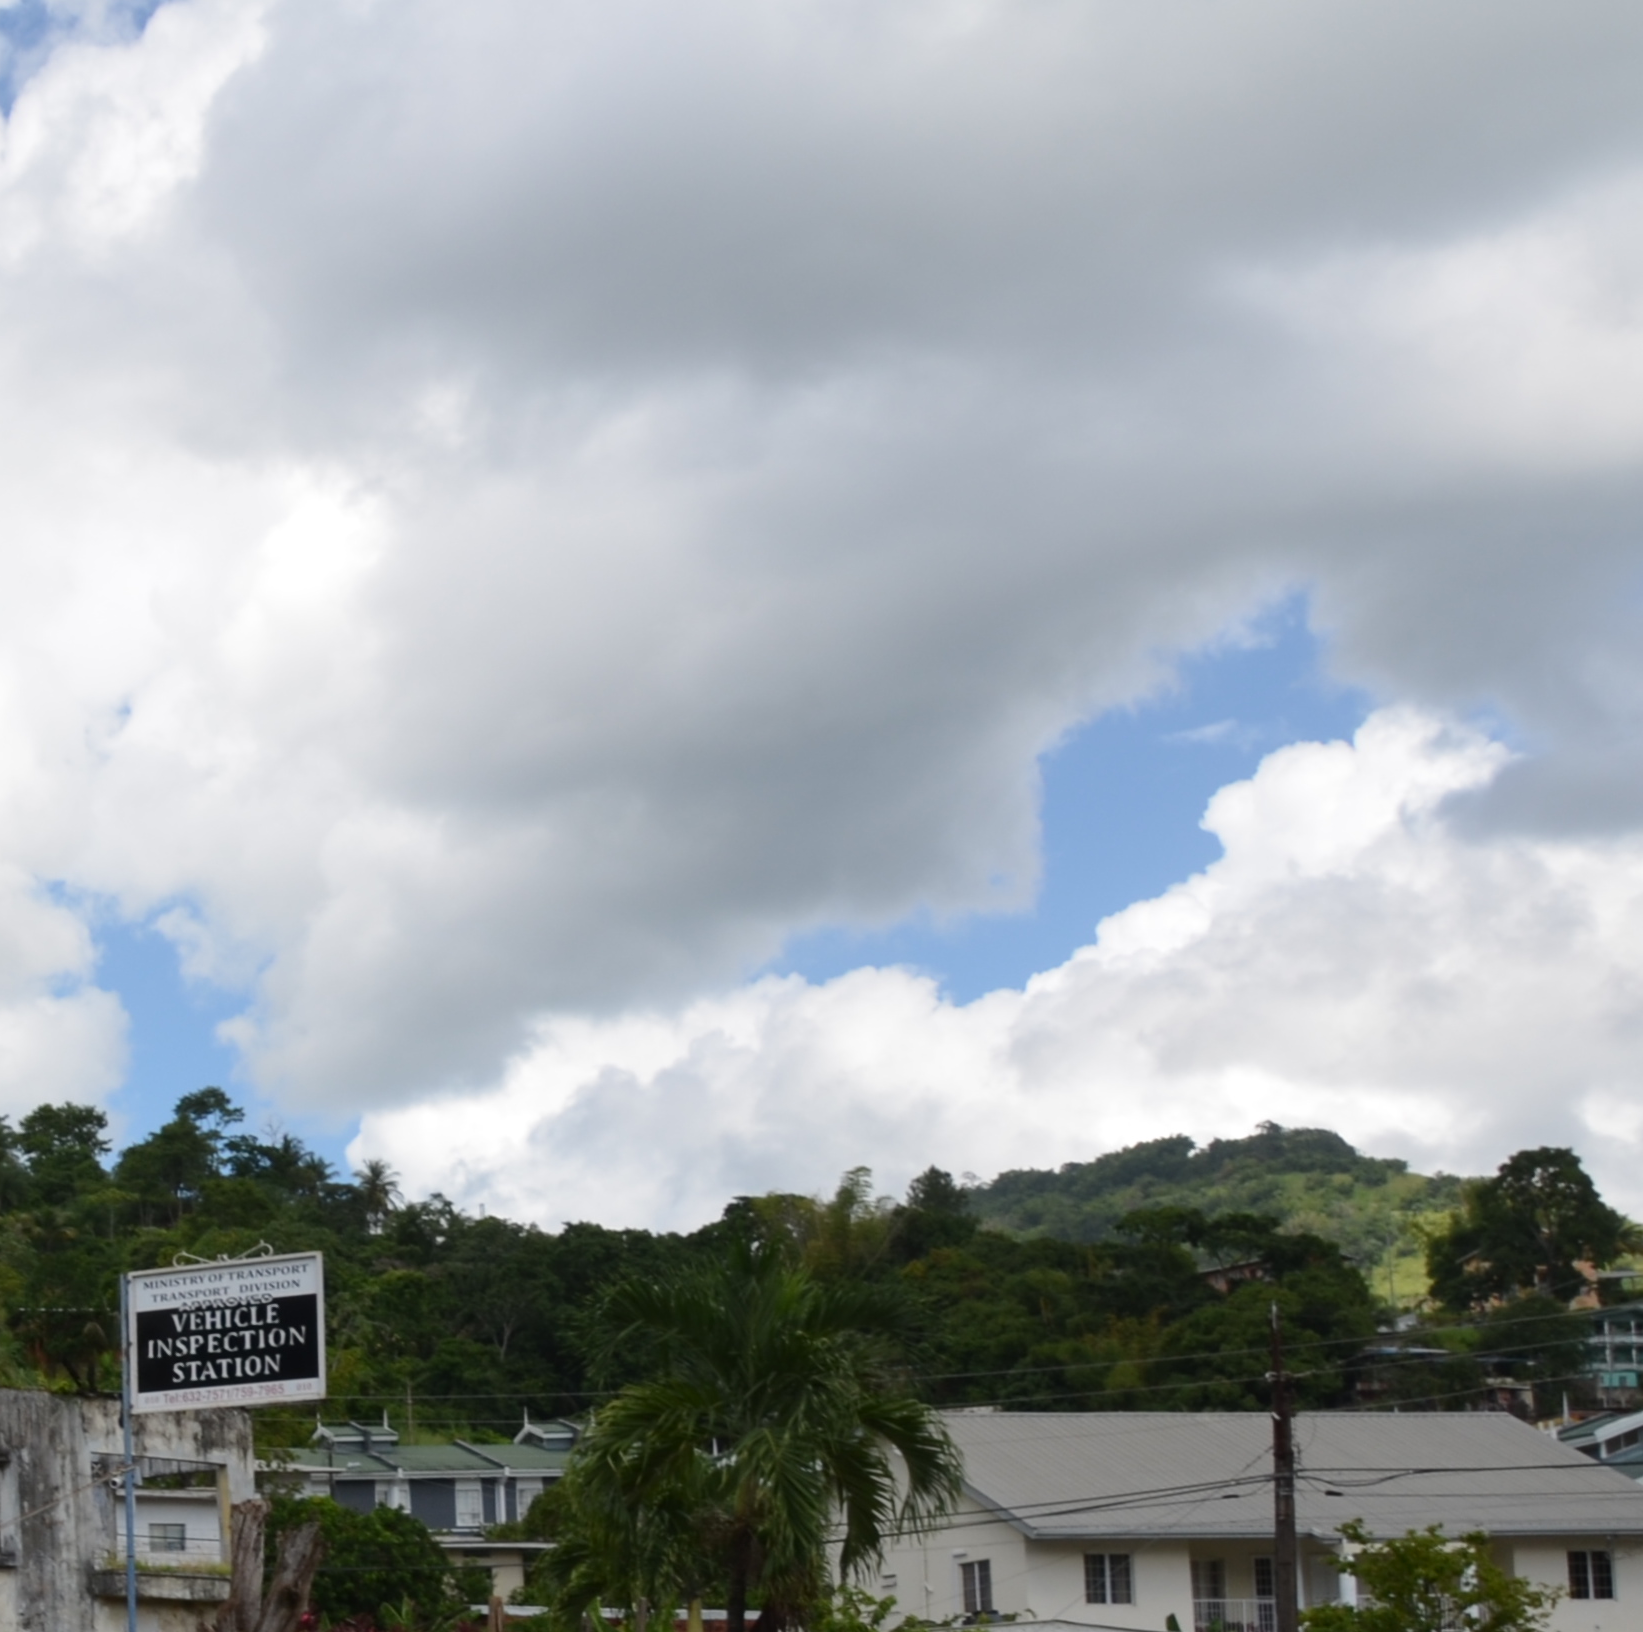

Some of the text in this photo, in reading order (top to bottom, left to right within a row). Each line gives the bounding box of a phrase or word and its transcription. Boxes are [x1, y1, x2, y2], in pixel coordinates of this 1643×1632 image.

[143, 1264, 309, 1290] MINISTRY OF TRANSPORT
[151, 1279, 301, 1303] TRANSPORT DIVISION
[178, 1293, 274, 1312] APPROVED
[171, 1303, 280, 1333] VEHICLE
[147, 1325, 306, 1359] INSPECTION
[172, 1354, 281, 1383] STATION
